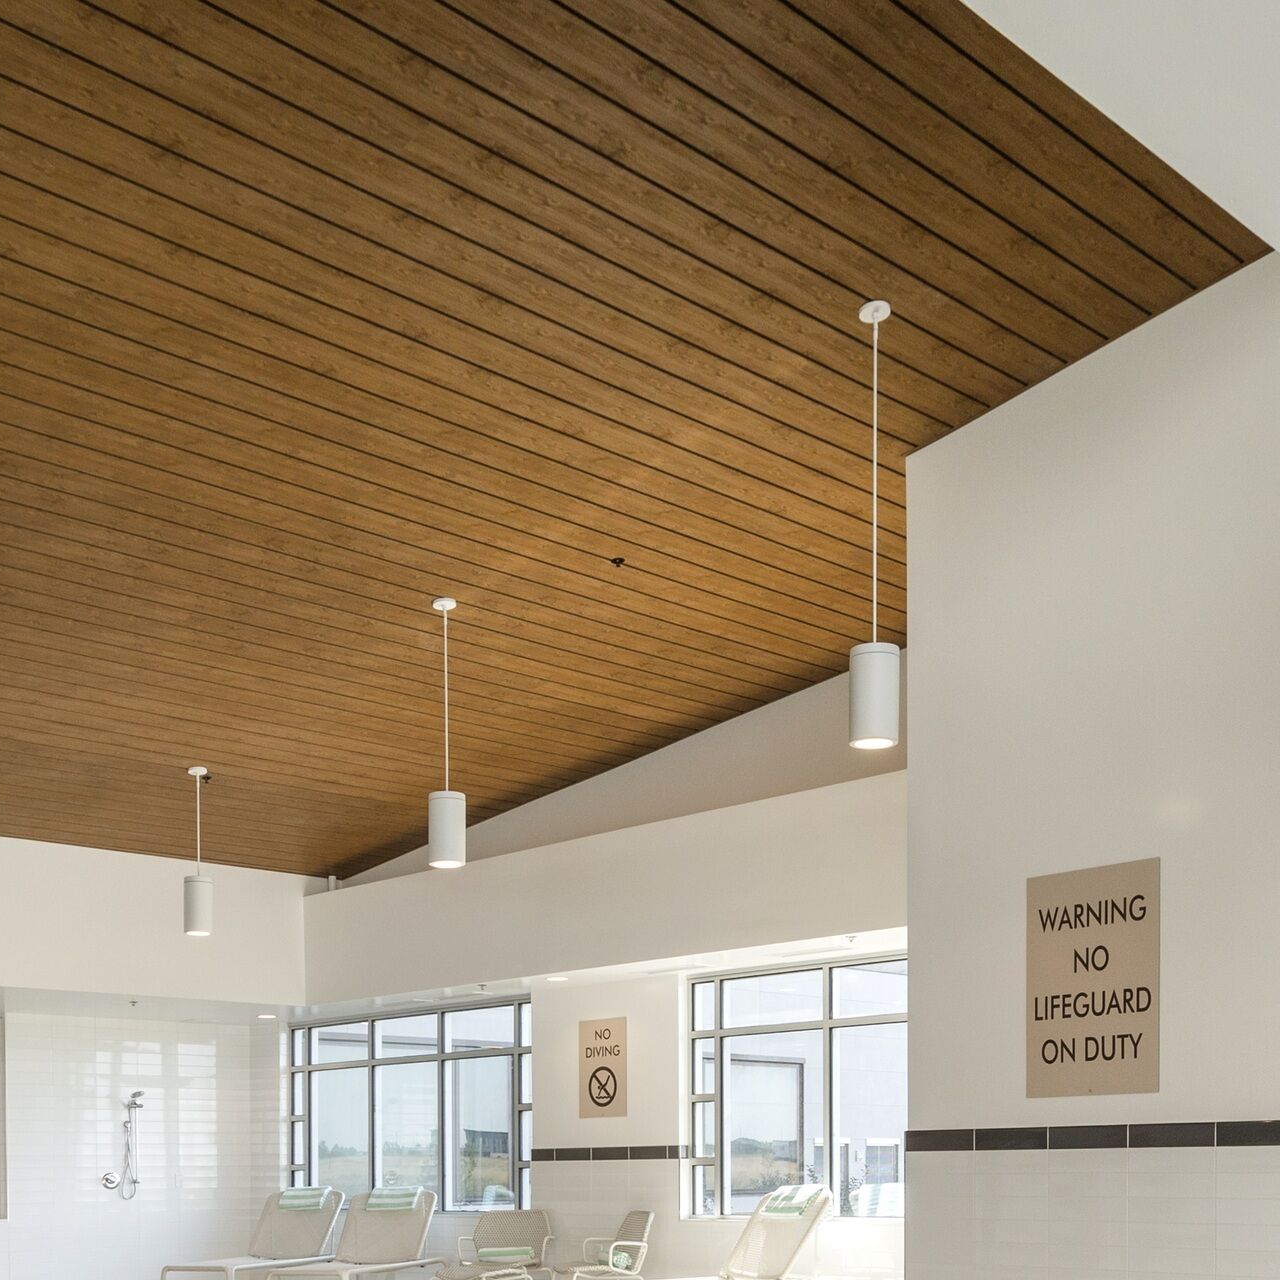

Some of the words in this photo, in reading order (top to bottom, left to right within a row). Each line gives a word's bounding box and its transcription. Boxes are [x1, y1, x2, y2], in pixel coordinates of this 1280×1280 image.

[1038, 894, 1147, 933] WARNING
[1073, 945, 1110, 974] NO
[1034, 986, 1152, 1022] LIFEGUARD
[594, 1028, 611, 1041] NO
[1041, 1038, 1076, 1065] ON
[1084, 1032, 1143, 1062] DUTY
[585, 1044, 620, 1058] DIVING
